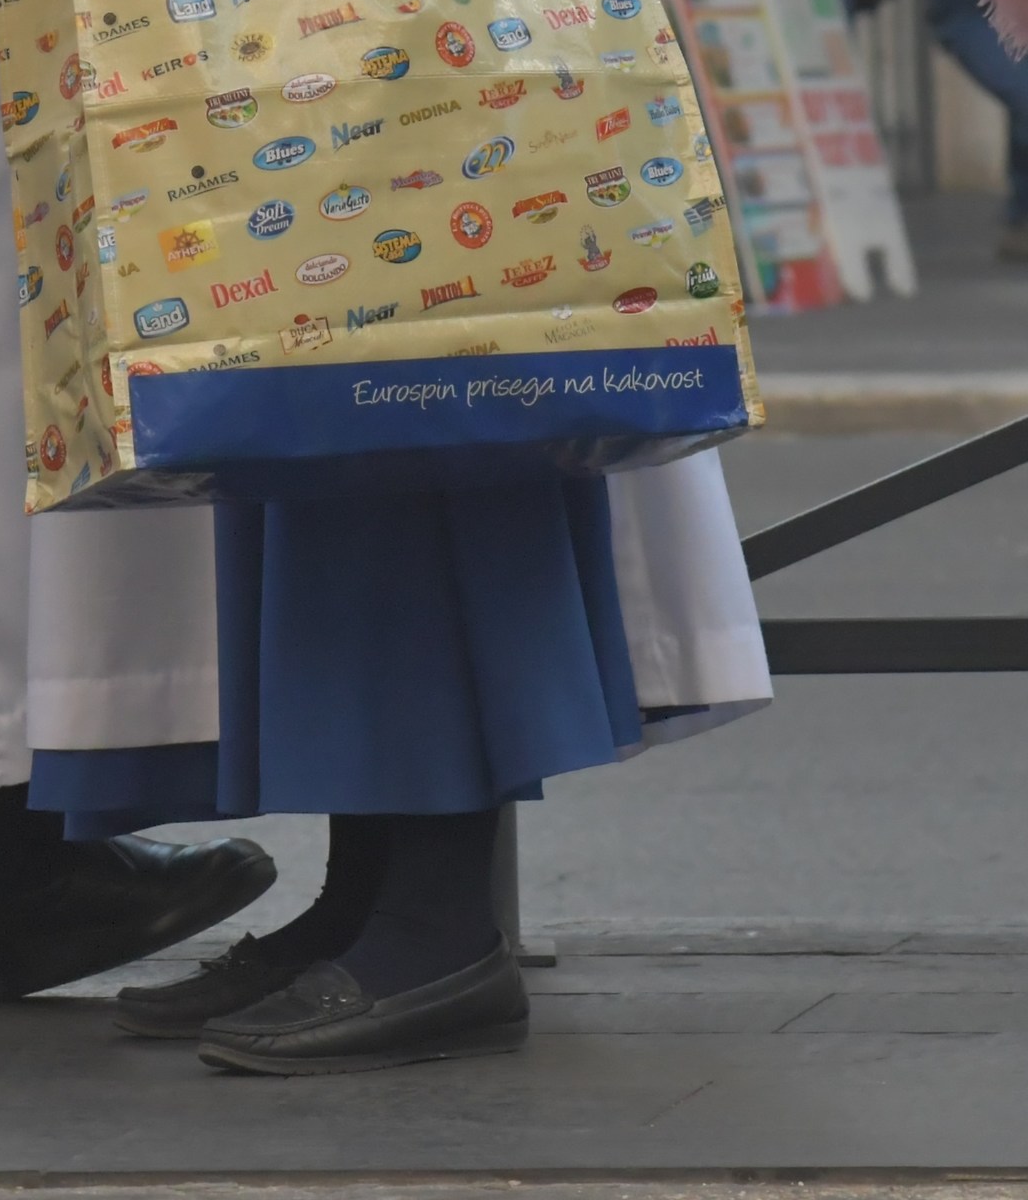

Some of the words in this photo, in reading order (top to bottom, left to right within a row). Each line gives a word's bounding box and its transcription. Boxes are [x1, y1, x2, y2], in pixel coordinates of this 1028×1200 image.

[543, 5, 596, 30] Dexal
[610, 0, 634, 12] Blues
[496, 25, 526, 46] Land
[288, 81, 333, 100] DOLCIANDO
[399, 99, 462, 126] ONDINA
[331, 118, 385, 150] Near
[266, 143, 305, 164] Blues
[647, 165, 674, 180] Blues
[167, 170, 239, 201] RADAMES
[256, 200, 285, 221] Soft
[256, 219, 290, 235] Dream
[373, 232, 420, 257] SISTEMA
[302, 263, 346, 282] DOLCIANDO
[501, 255, 556, 284] JEREZ
[686, 267, 716, 290] fruit
[210, 268, 279, 308] Dexal
[141, 306, 183, 332] Land
[347, 301, 399, 334] Near
[289, 323, 318, 338] DUCA
[352, 378, 457, 410] Eurospin
[467, 374, 555, 407] prisega
[564, 376, 596, 394] na
[604, 365, 705, 393] kakovost
